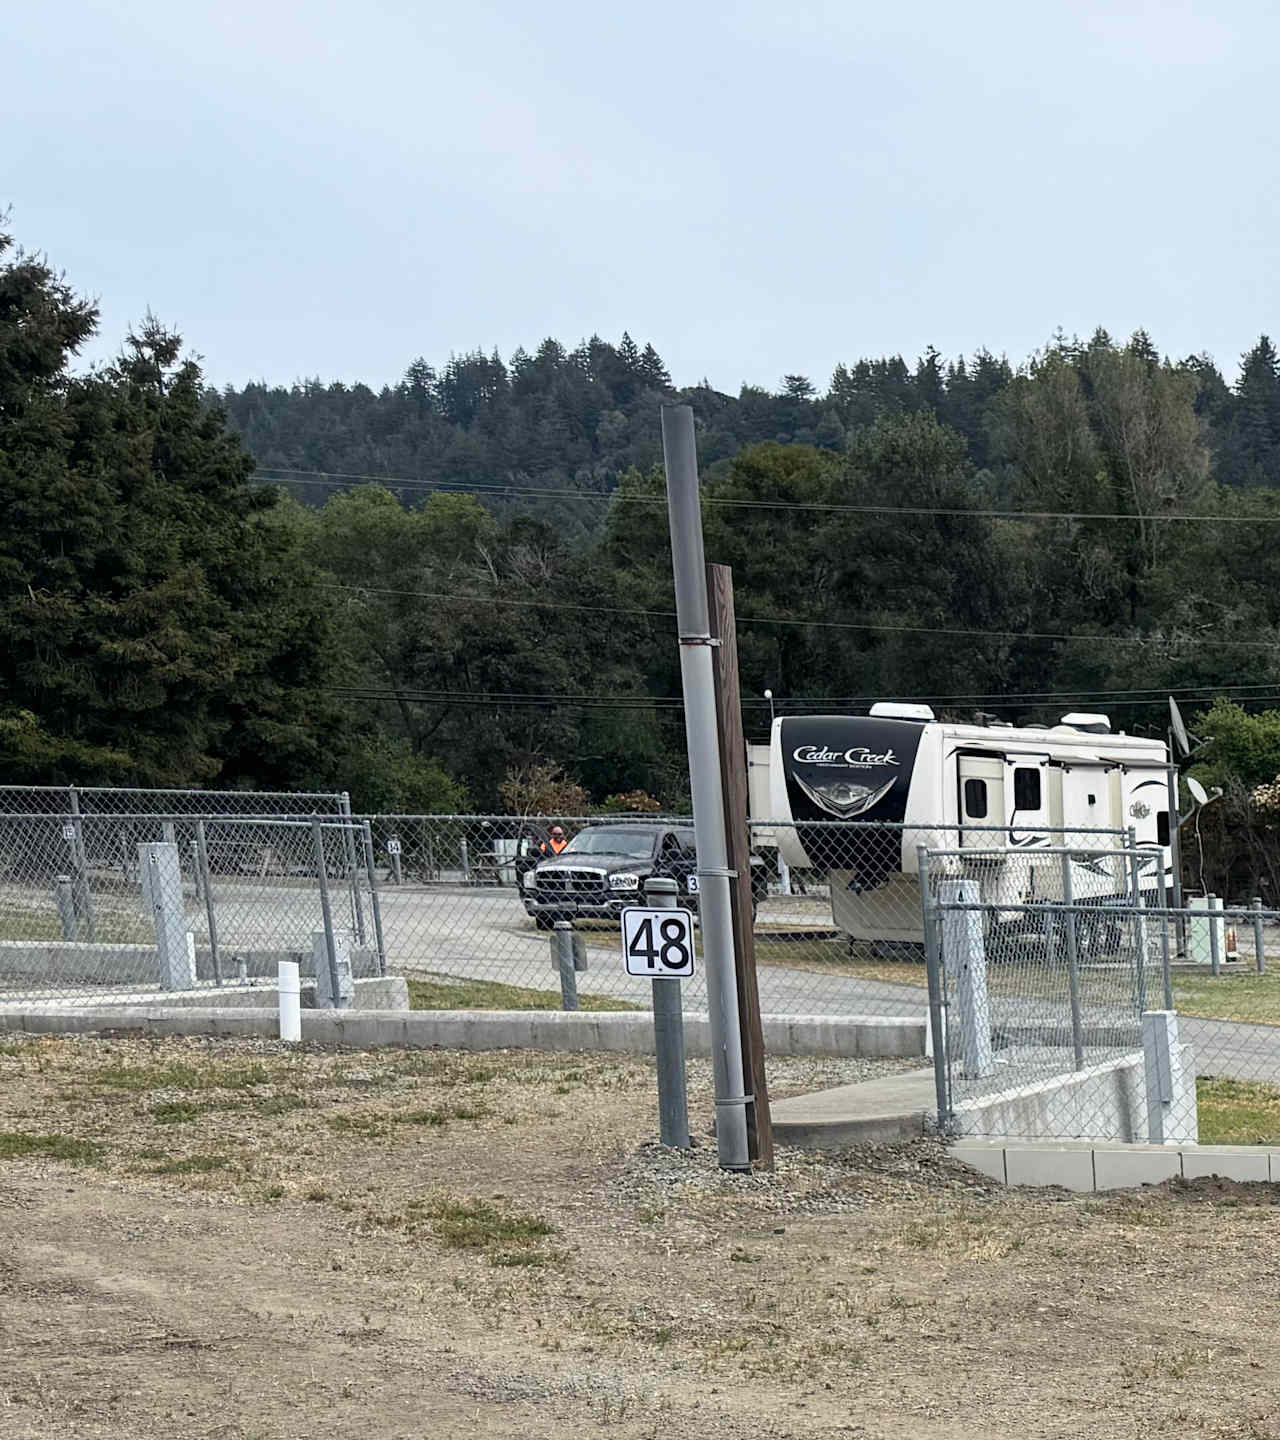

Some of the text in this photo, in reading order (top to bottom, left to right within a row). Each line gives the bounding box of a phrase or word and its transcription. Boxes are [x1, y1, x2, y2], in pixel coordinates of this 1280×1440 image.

[793, 746, 901, 765] Cedar Creek
[629, 918, 689, 969] 48
